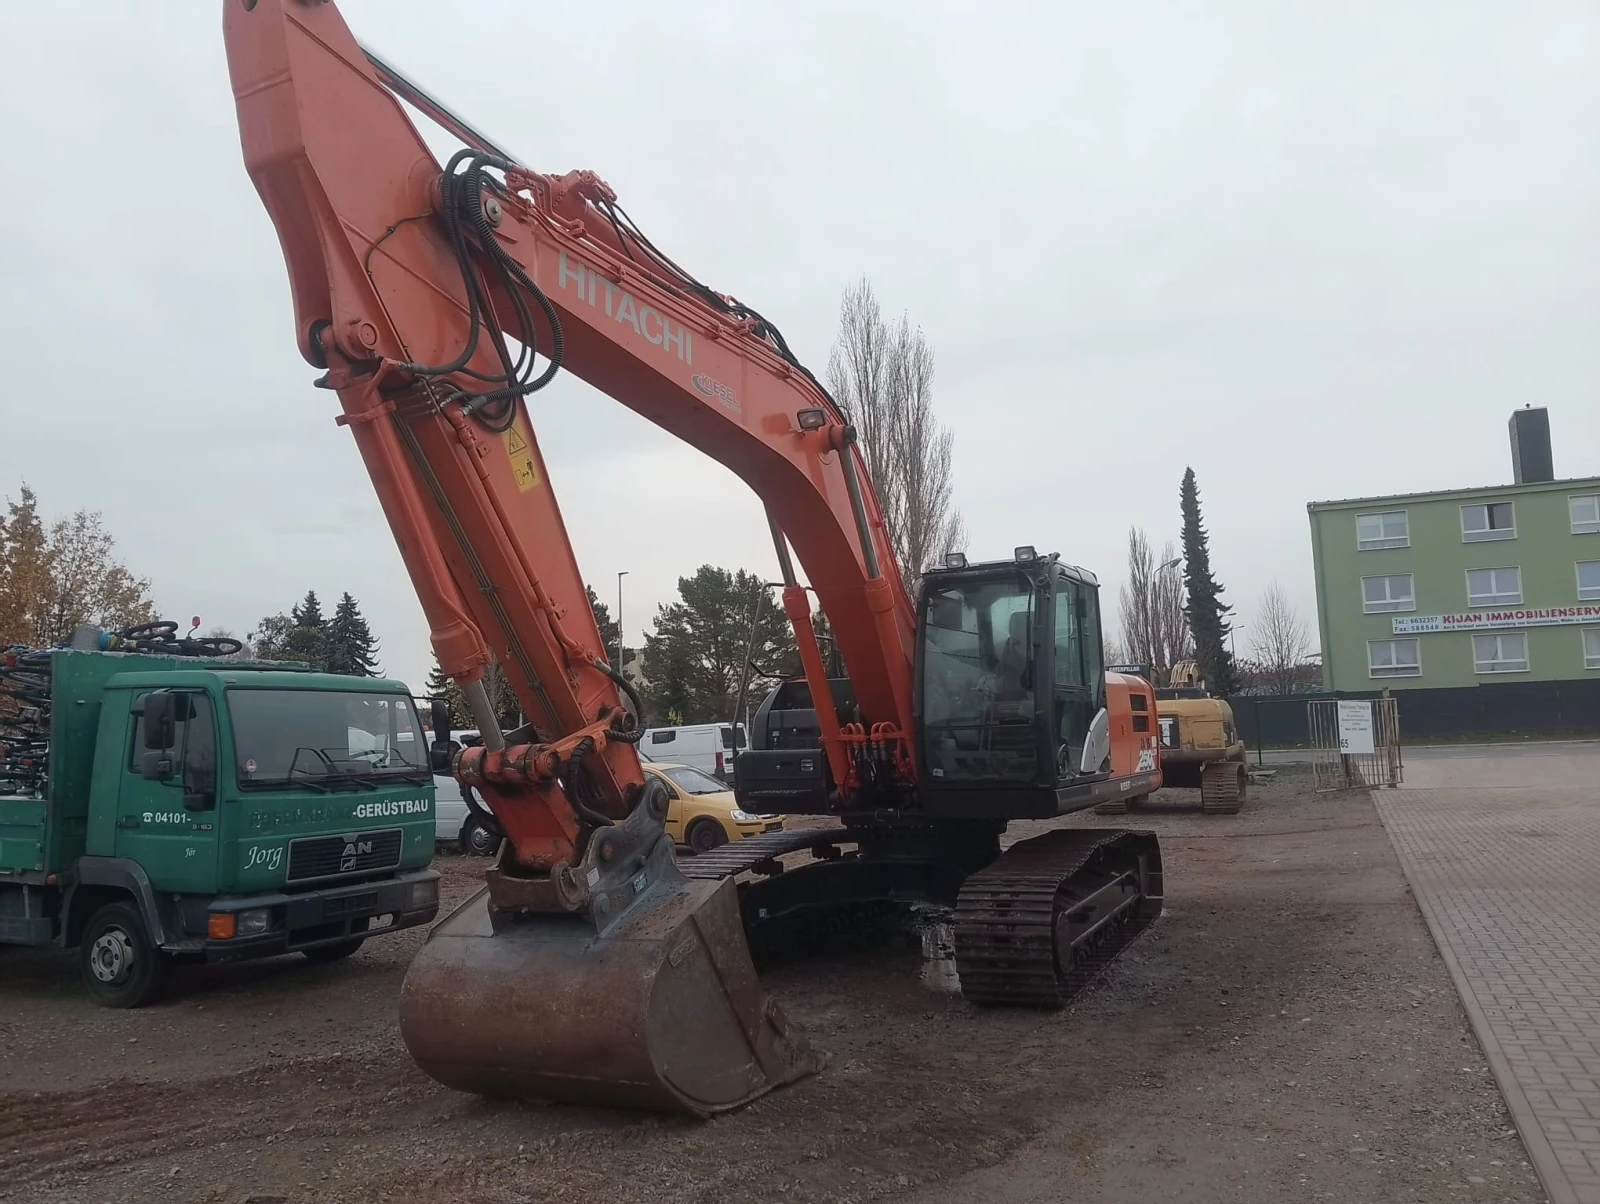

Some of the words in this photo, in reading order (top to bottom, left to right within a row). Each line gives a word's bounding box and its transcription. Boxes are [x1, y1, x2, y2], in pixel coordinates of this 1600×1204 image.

[558, 251, 692, 365] HITACHI
[698, 373, 739, 405] KIESEL
[1443, 613, 1482, 624] KIJAN
[1486, 606, 1600, 621] IMMOBILIENSERV
[155, 812, 191, 824] 04101-
[353, 798, 429, 818] -GERÜSTBAU
[243, 846, 283, 870] Jorg
[341, 841, 372, 856] AN
